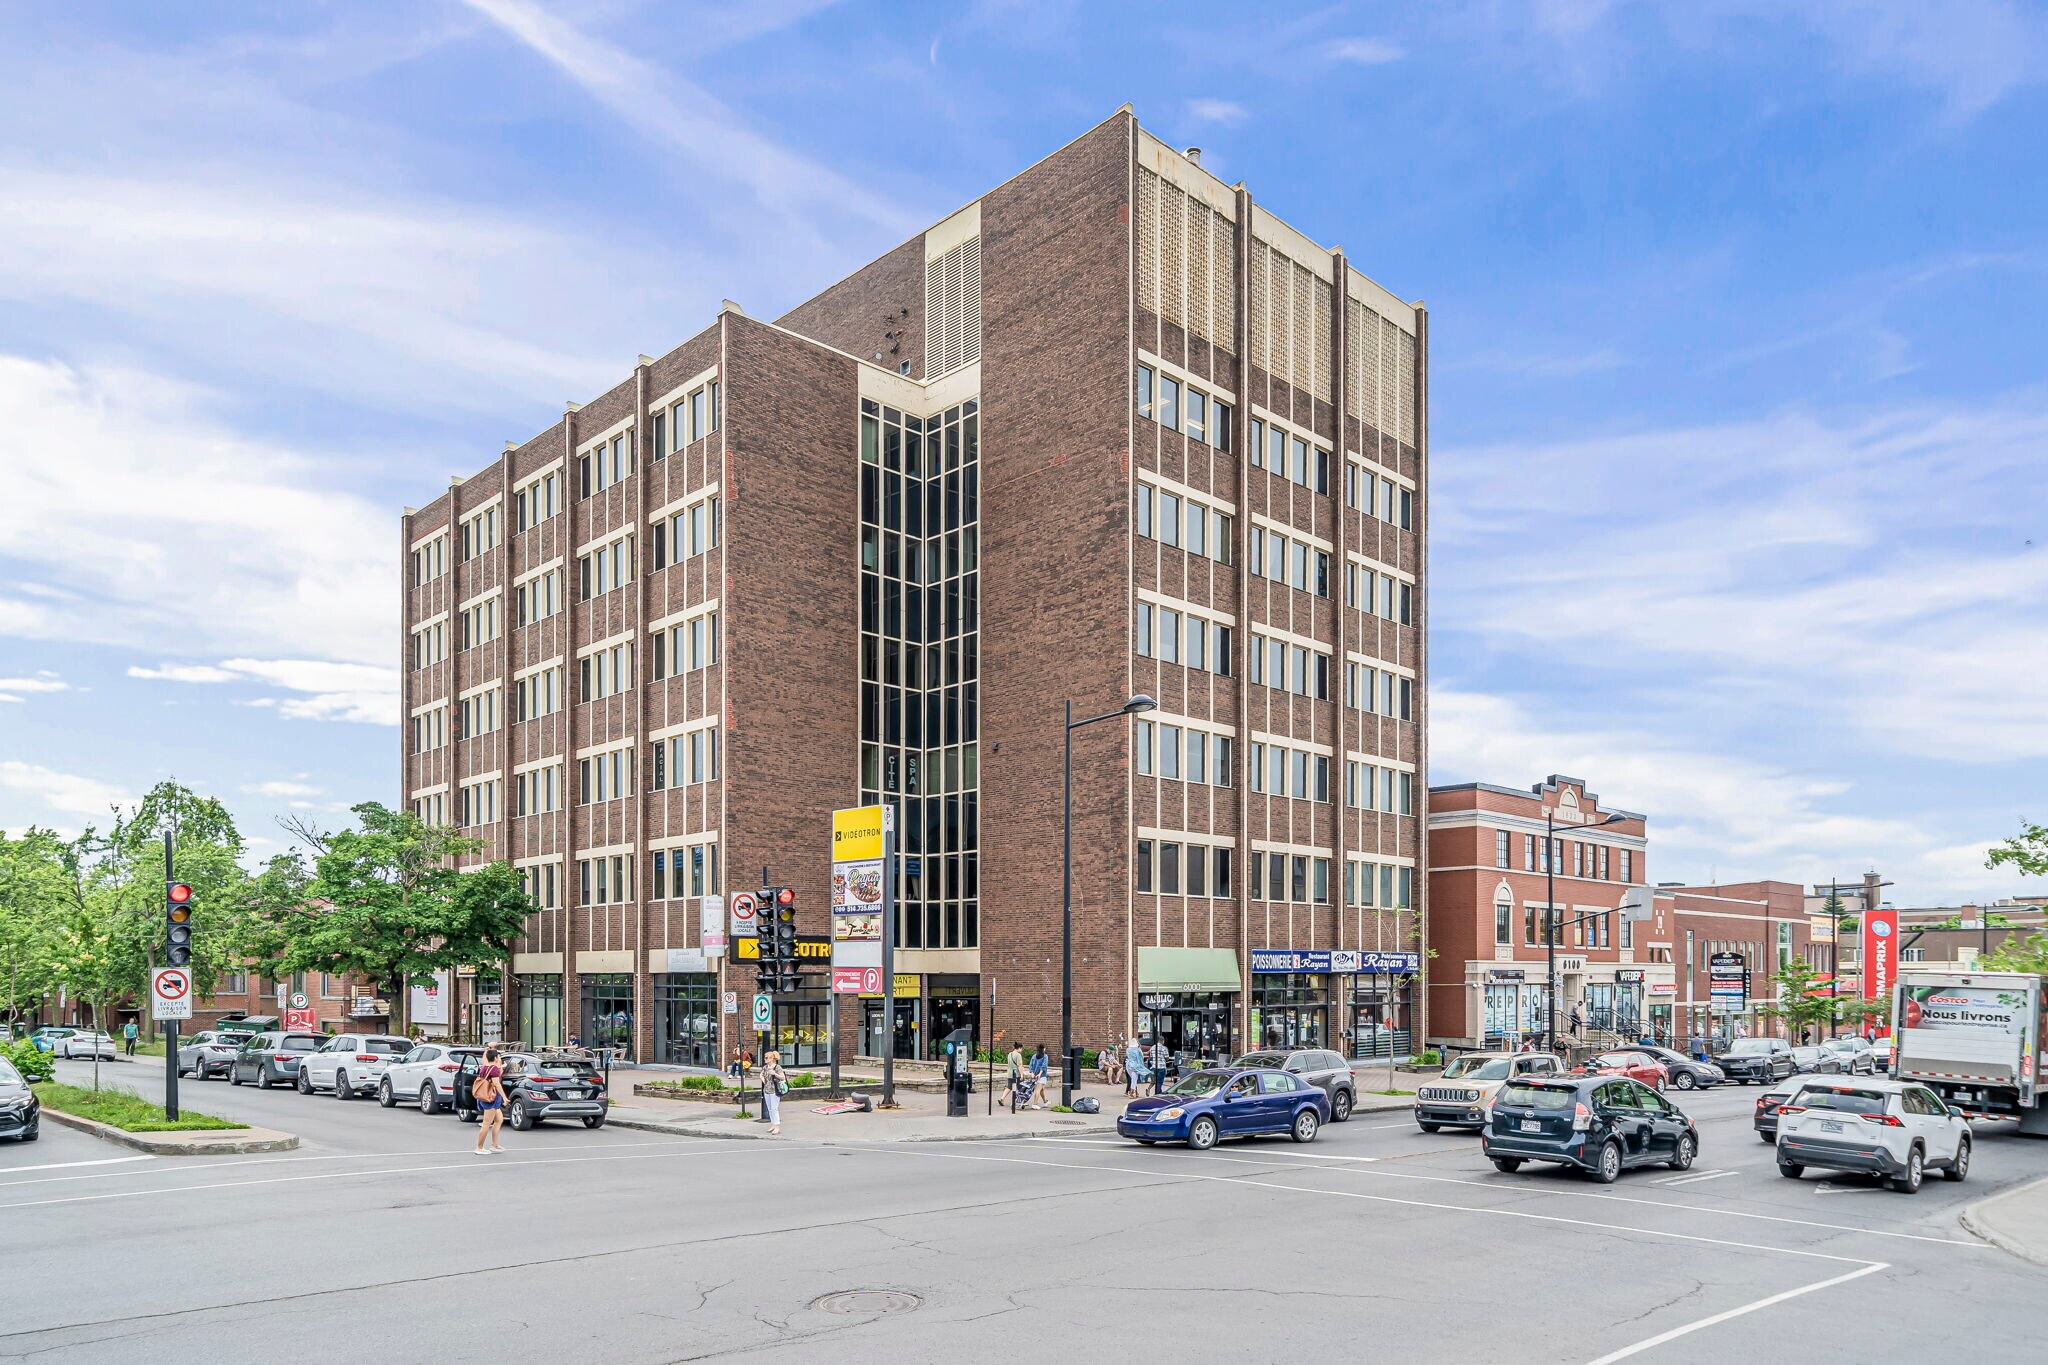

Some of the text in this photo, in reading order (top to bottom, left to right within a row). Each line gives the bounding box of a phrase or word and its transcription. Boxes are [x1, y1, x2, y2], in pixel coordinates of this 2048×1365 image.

[1252, 954, 1292, 969] POISSONNERIE
[1300, 958, 1329, 970] Rayan
[1363, 954, 1403, 970] Rayan
[1563, 960, 1581, 970] 6100
[868, 972, 876, 988] P
[1183, 983, 1201, 991] 6000
[1928, 996, 1969, 1004] COSTCO
[1922, 1009, 2011, 1022] Nous livrons
